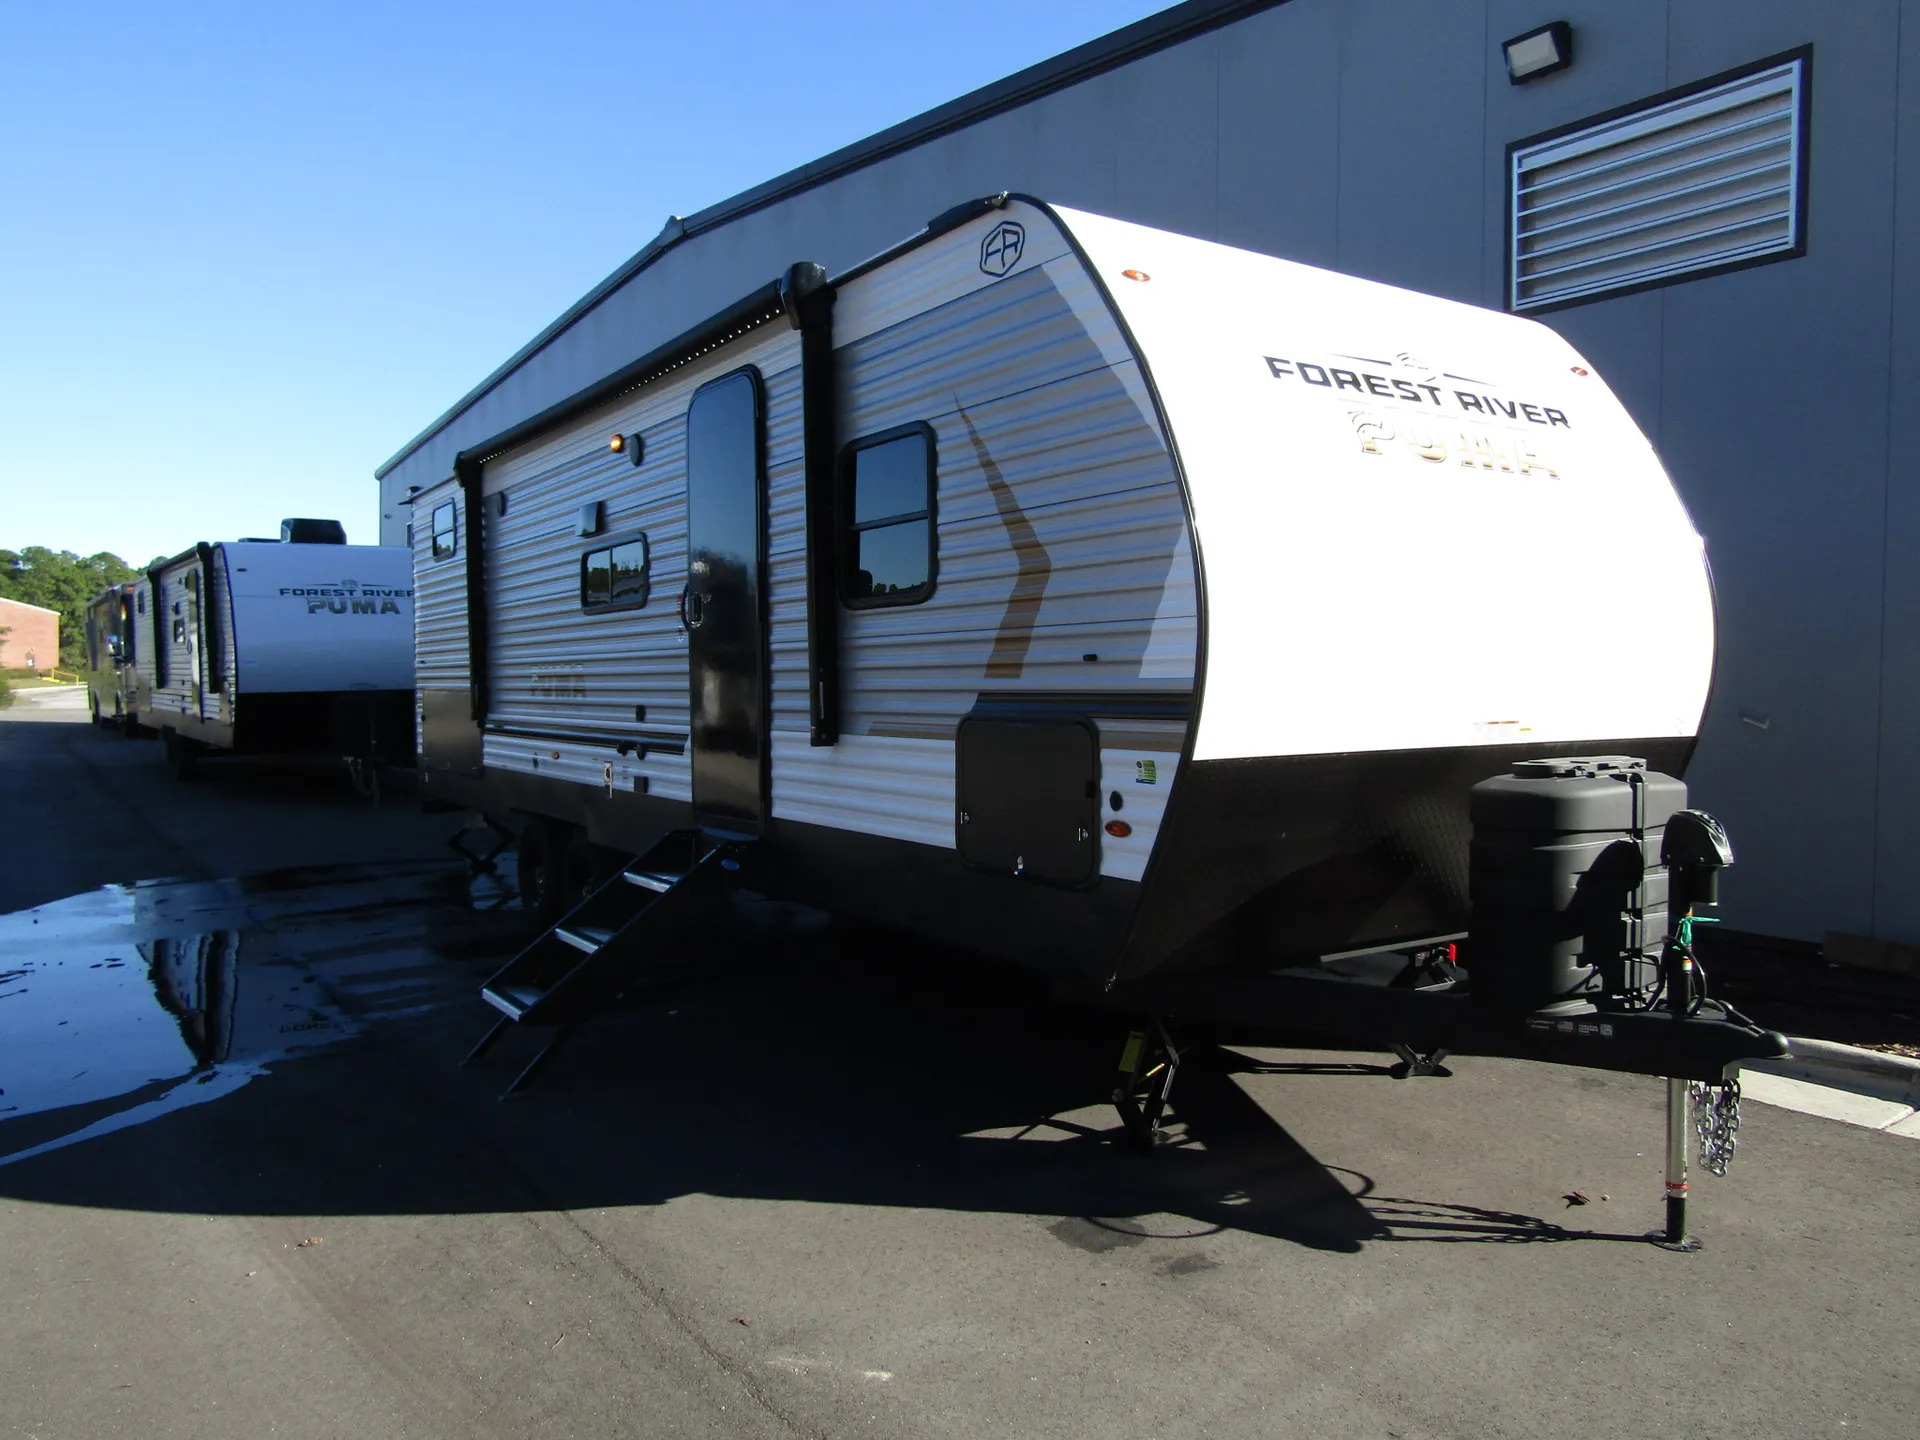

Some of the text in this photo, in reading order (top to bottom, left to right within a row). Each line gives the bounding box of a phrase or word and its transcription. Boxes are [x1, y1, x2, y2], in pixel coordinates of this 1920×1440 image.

[1262, 355, 1572, 429] FOREST RIVER
[279, 588, 358, 597] FOREST
[307, 598, 402, 615] PUMA
